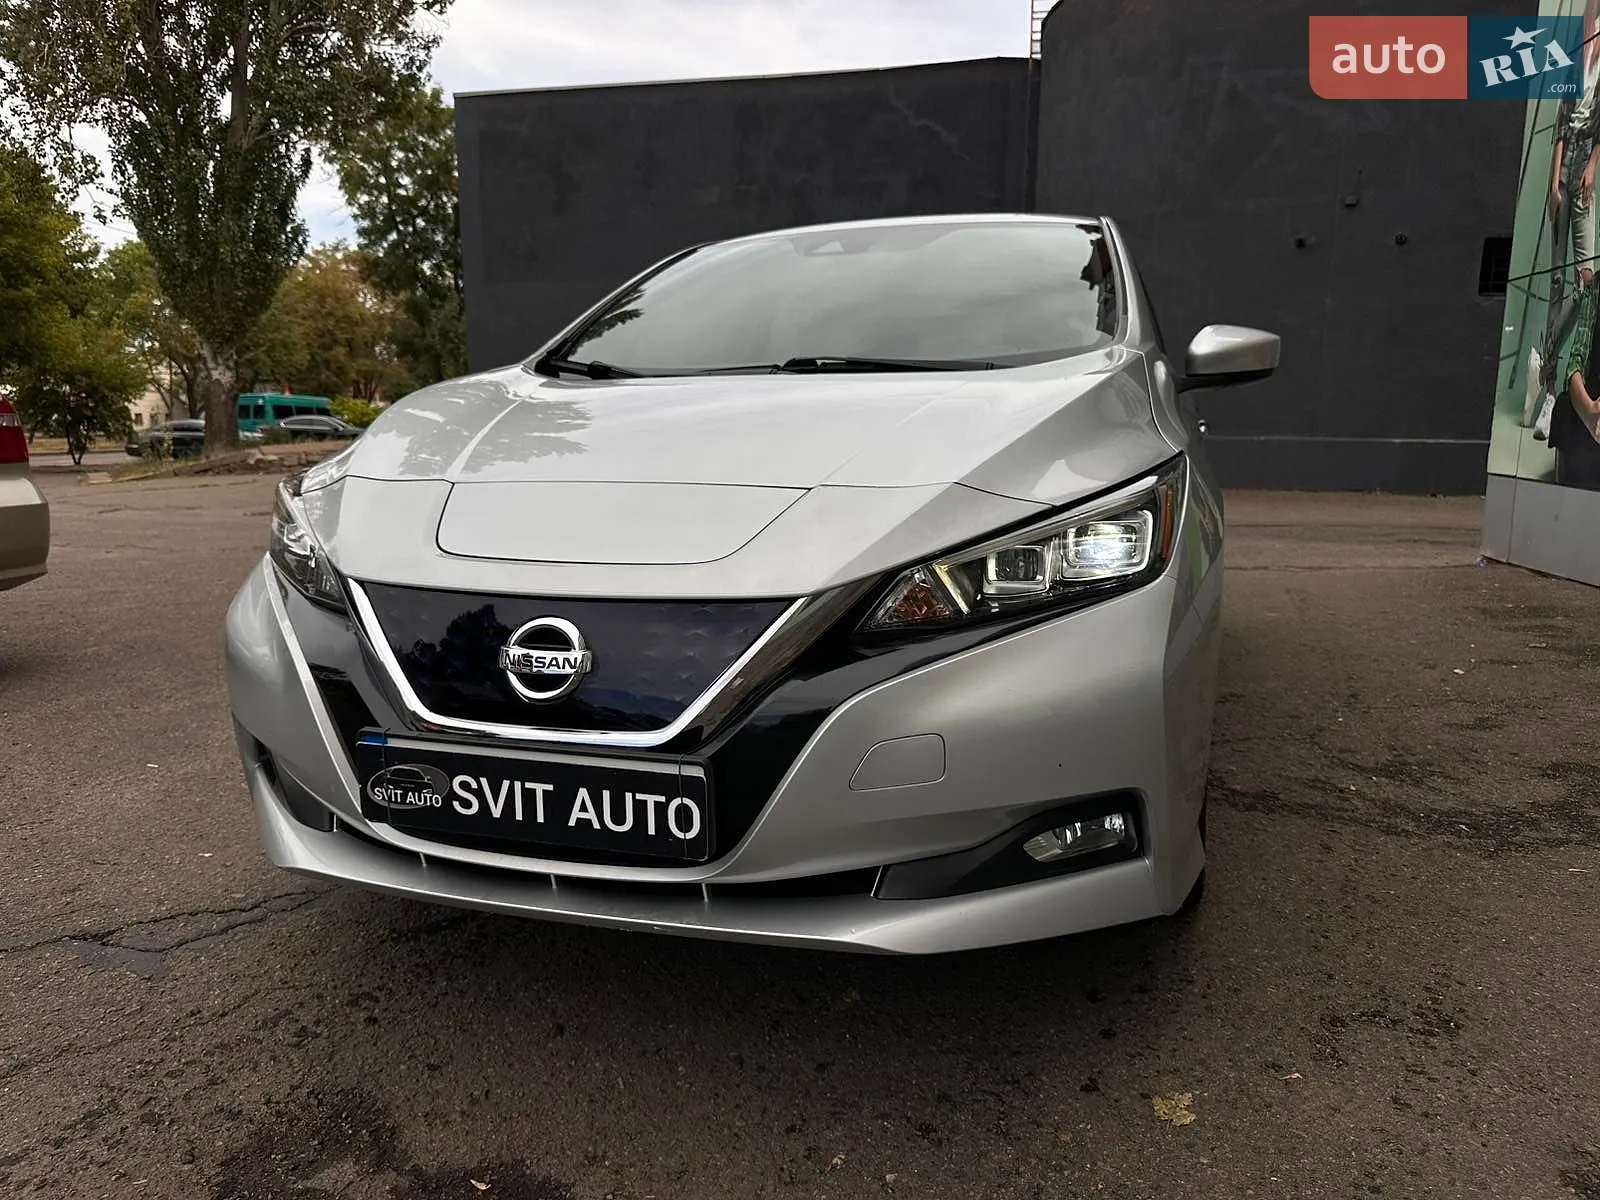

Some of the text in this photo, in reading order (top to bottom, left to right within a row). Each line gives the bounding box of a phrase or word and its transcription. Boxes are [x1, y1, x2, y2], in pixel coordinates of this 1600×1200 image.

[503, 651, 578, 671] NISSAN
[374, 787, 442, 808] SVIT AUTO
[452, 774, 701, 840] SVIT AUTO
